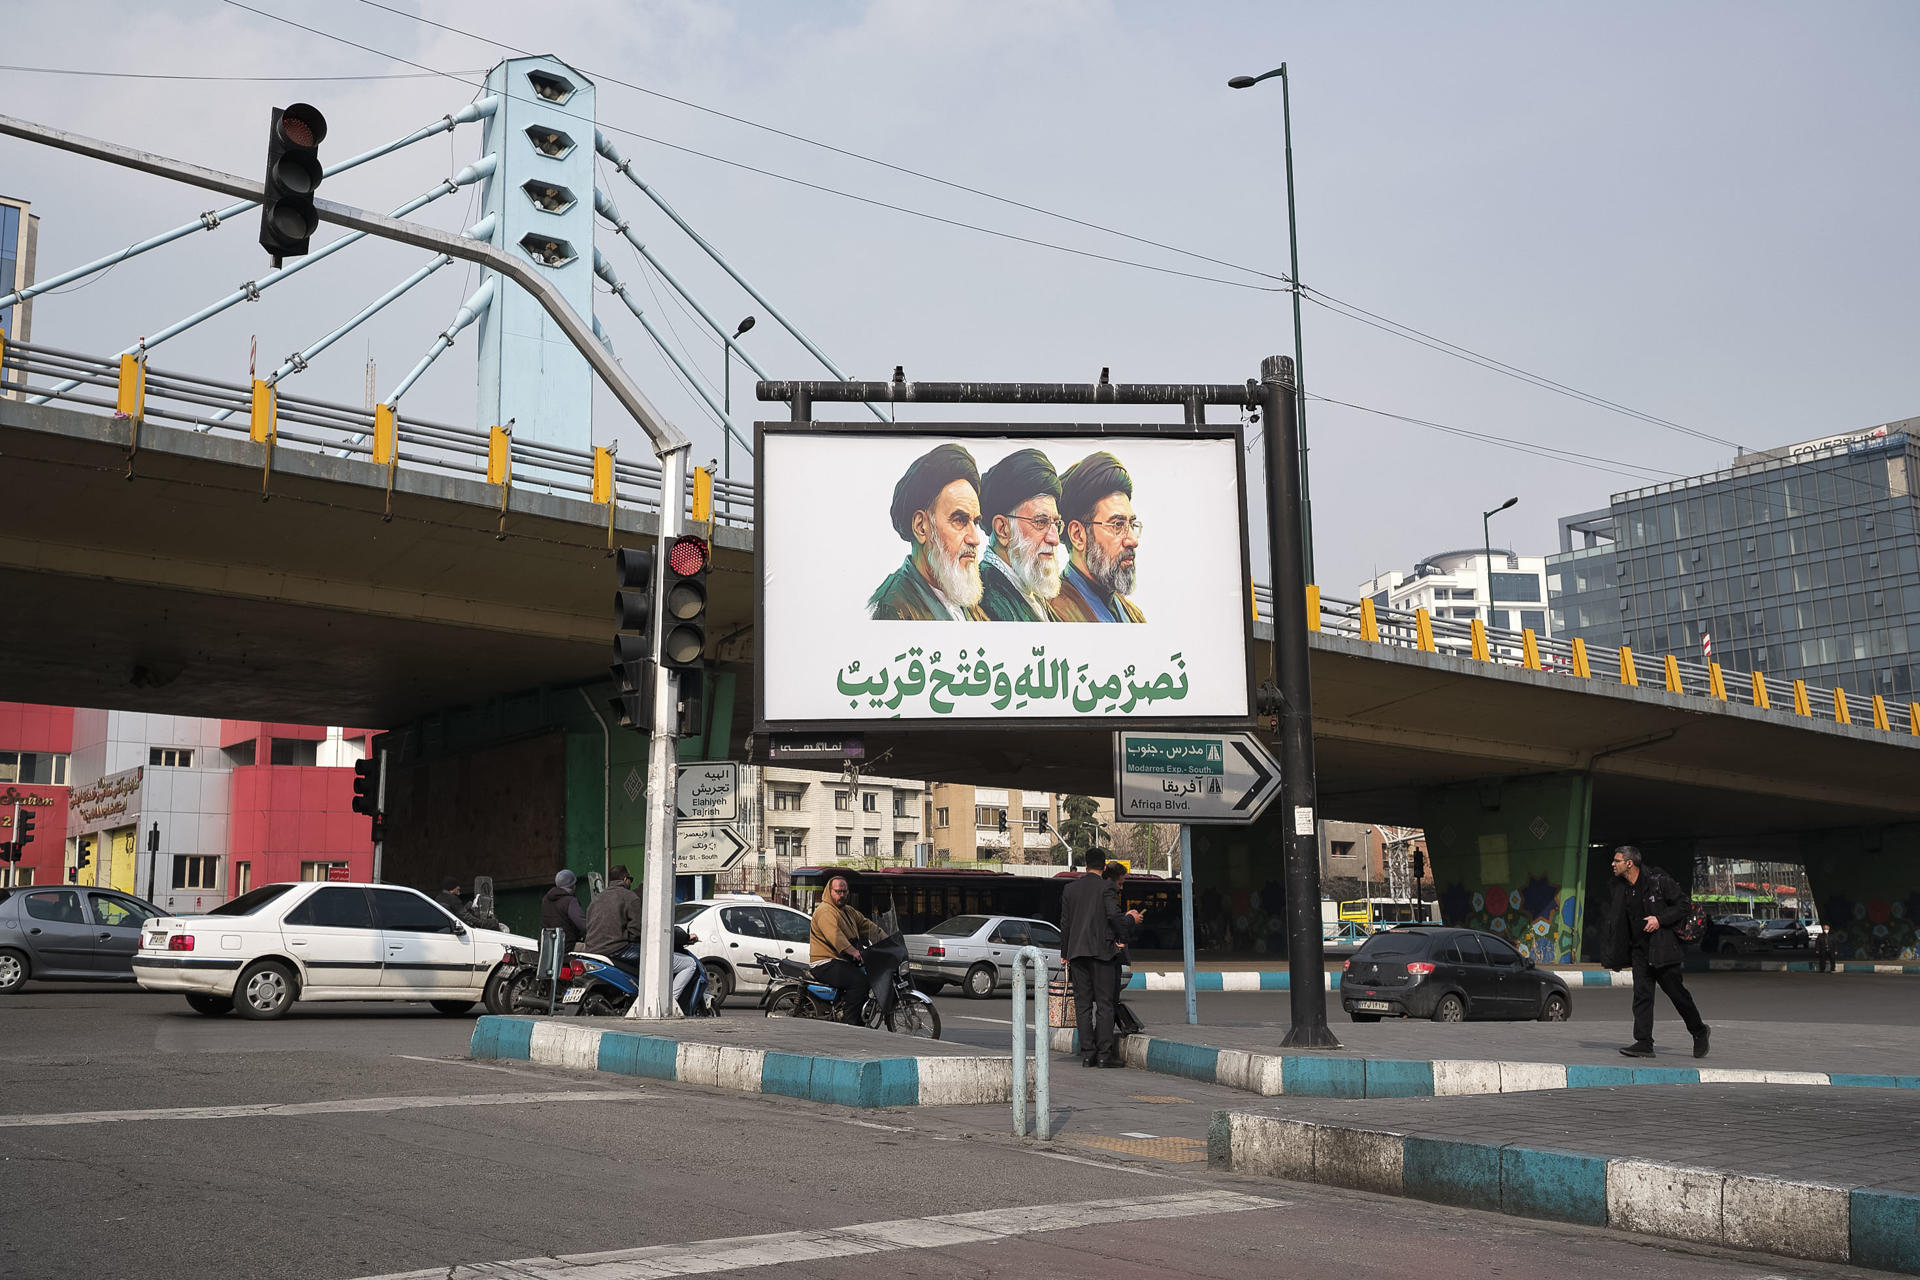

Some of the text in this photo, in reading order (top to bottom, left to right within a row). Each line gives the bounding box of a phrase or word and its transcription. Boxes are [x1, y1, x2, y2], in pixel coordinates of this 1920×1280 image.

[1127, 743, 1158, 758] جنوب
[1166, 744, 1204, 759] مدرس
[1127, 763, 1165, 773] Modarres
[704, 769, 729, 781] الهیه
[691, 783, 730, 797] تجریش
[1162, 776, 1204, 797] آفریقا
[692, 797, 727, 807] Elahiyeh
[1130, 799, 1191, 811] Afriqa Blvd.
[692, 807, 720, 817] Tajrish
